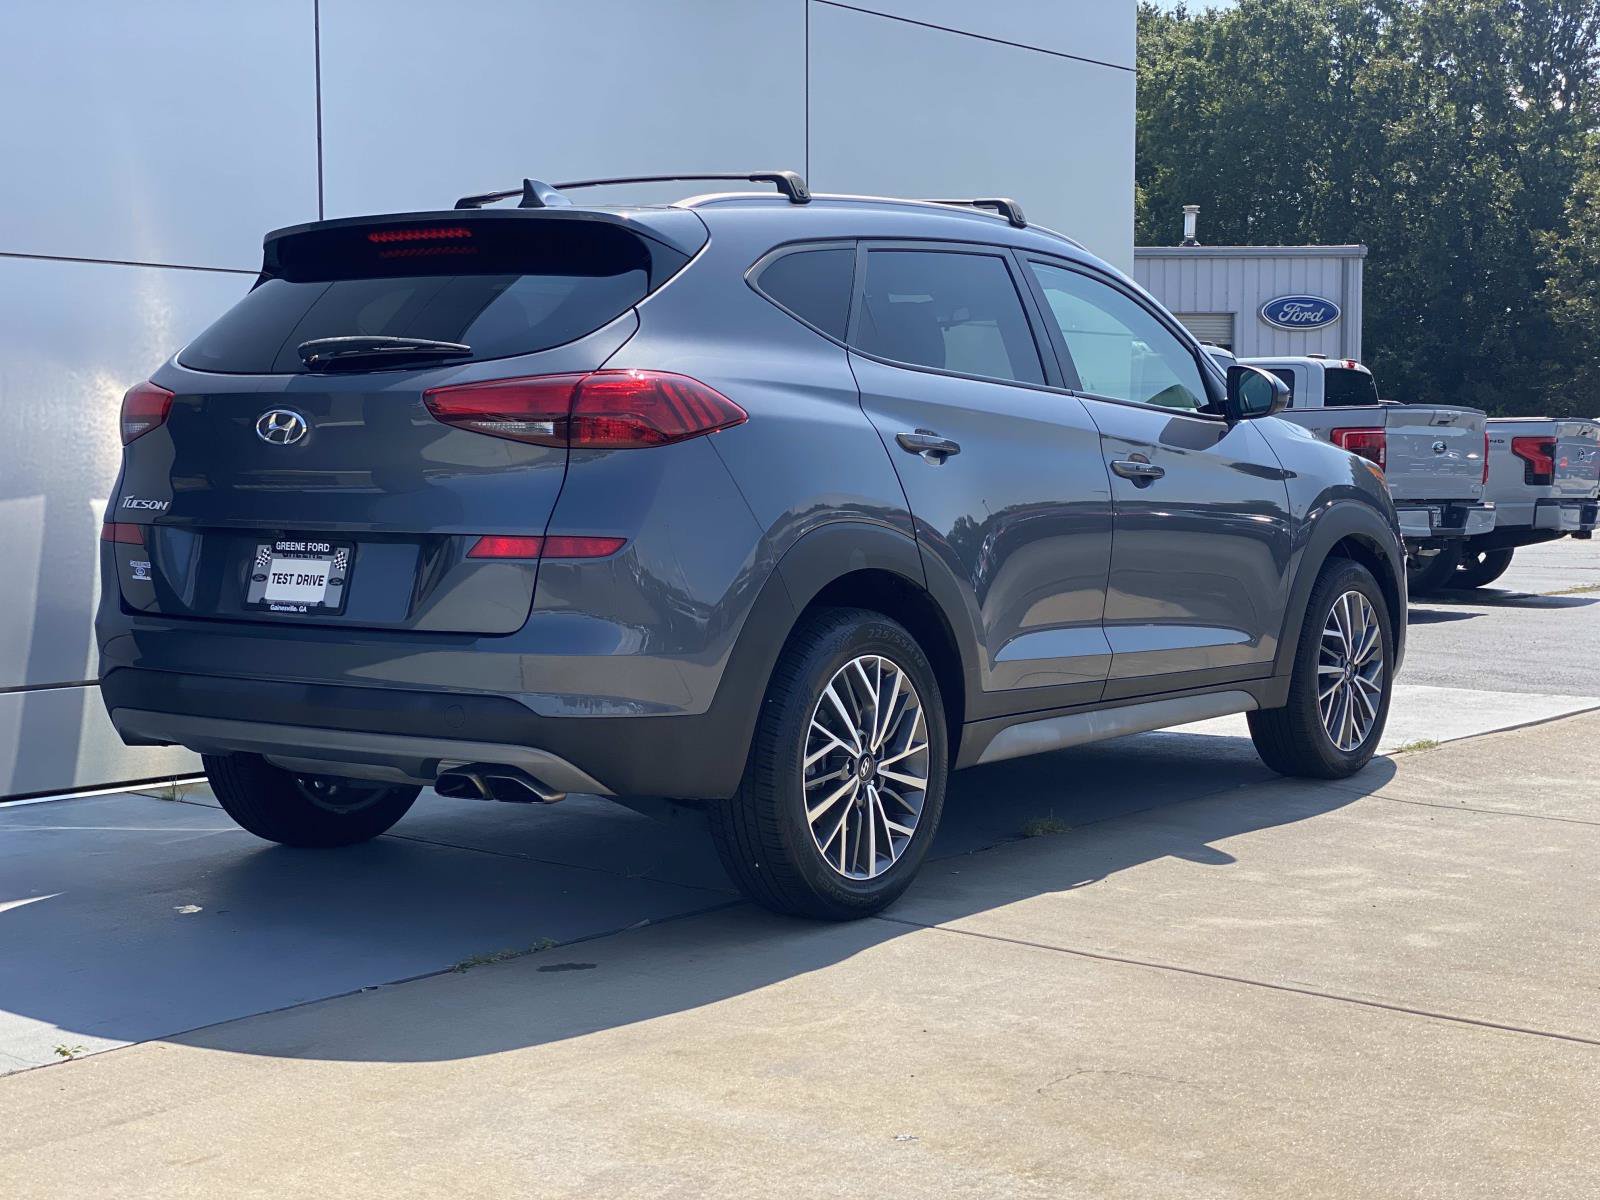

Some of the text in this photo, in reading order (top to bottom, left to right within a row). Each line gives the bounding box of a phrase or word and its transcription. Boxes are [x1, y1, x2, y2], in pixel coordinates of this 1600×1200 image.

[1278, 302, 1325, 322] Ford
[276, 541, 330, 552] GREENE FORD
[272, 572, 294, 585] TEST
[296, 574, 325, 586] DRIVE
[299, 605, 307, 613] GA
